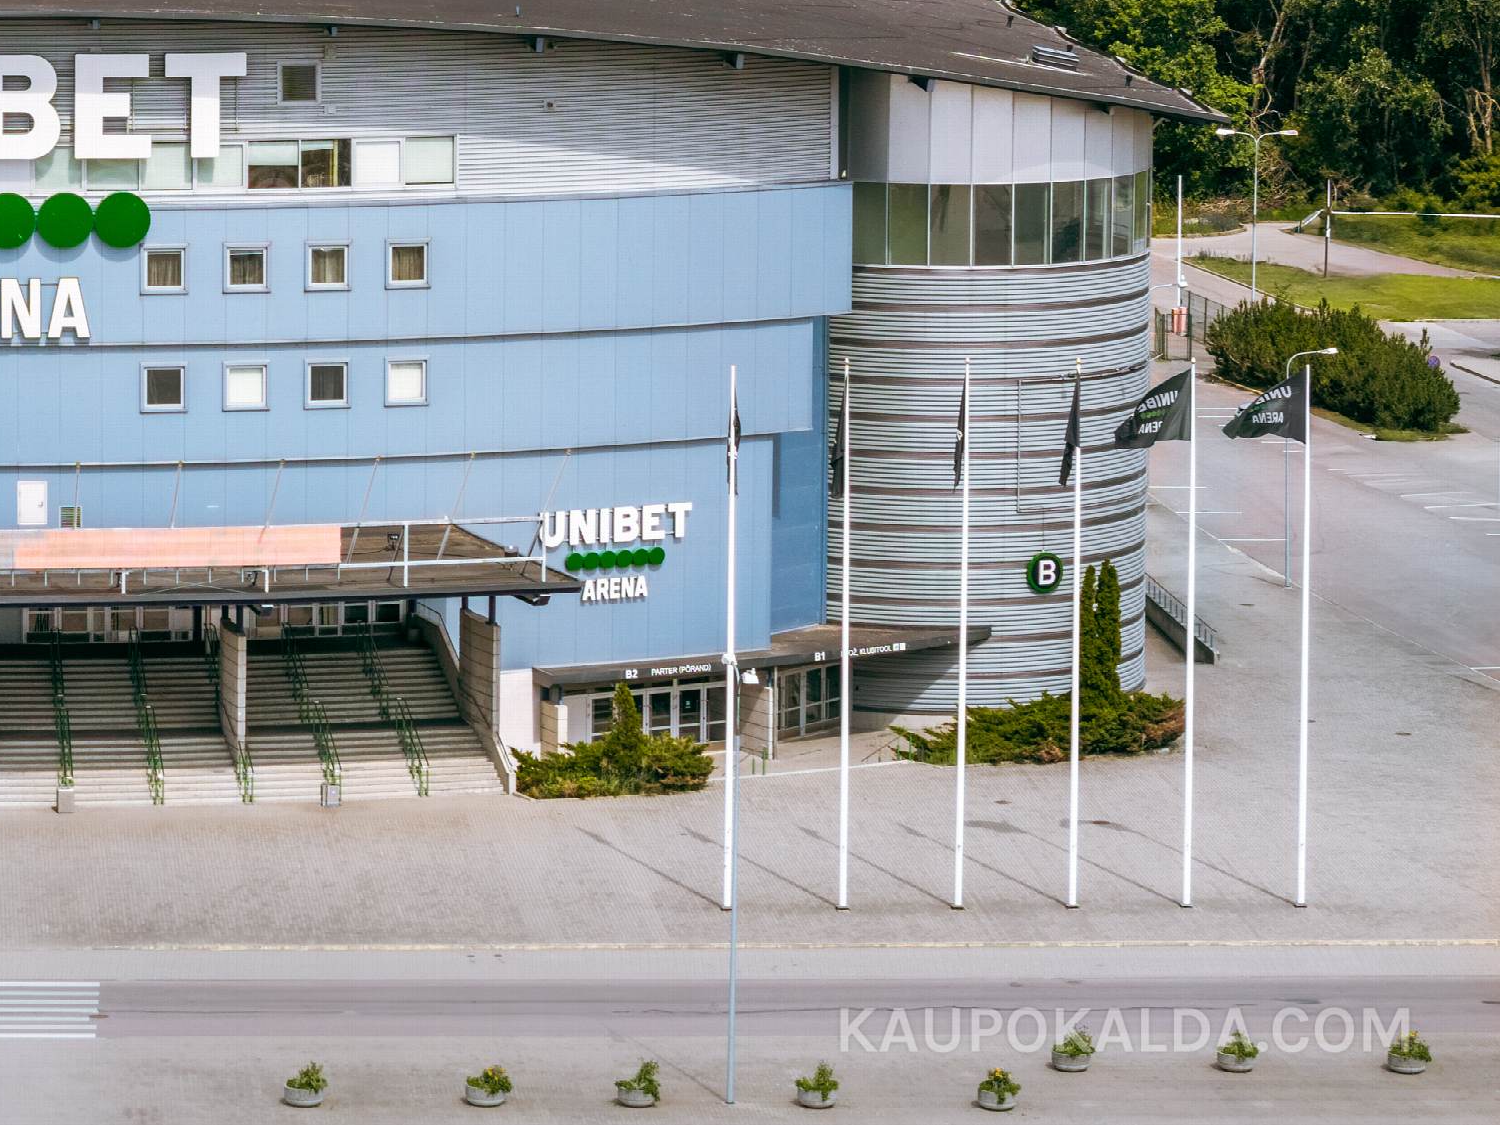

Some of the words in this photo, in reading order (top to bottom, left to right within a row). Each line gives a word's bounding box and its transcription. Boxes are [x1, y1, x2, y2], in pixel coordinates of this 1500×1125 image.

[539, 502, 693, 547] UNIBET
[1038, 559, 1057, 585] B
[582, 575, 649, 601] ARENA
[814, 651, 826, 662] B1
[625, 668, 638, 679] B2
[651, 665, 677, 676] PARTER
